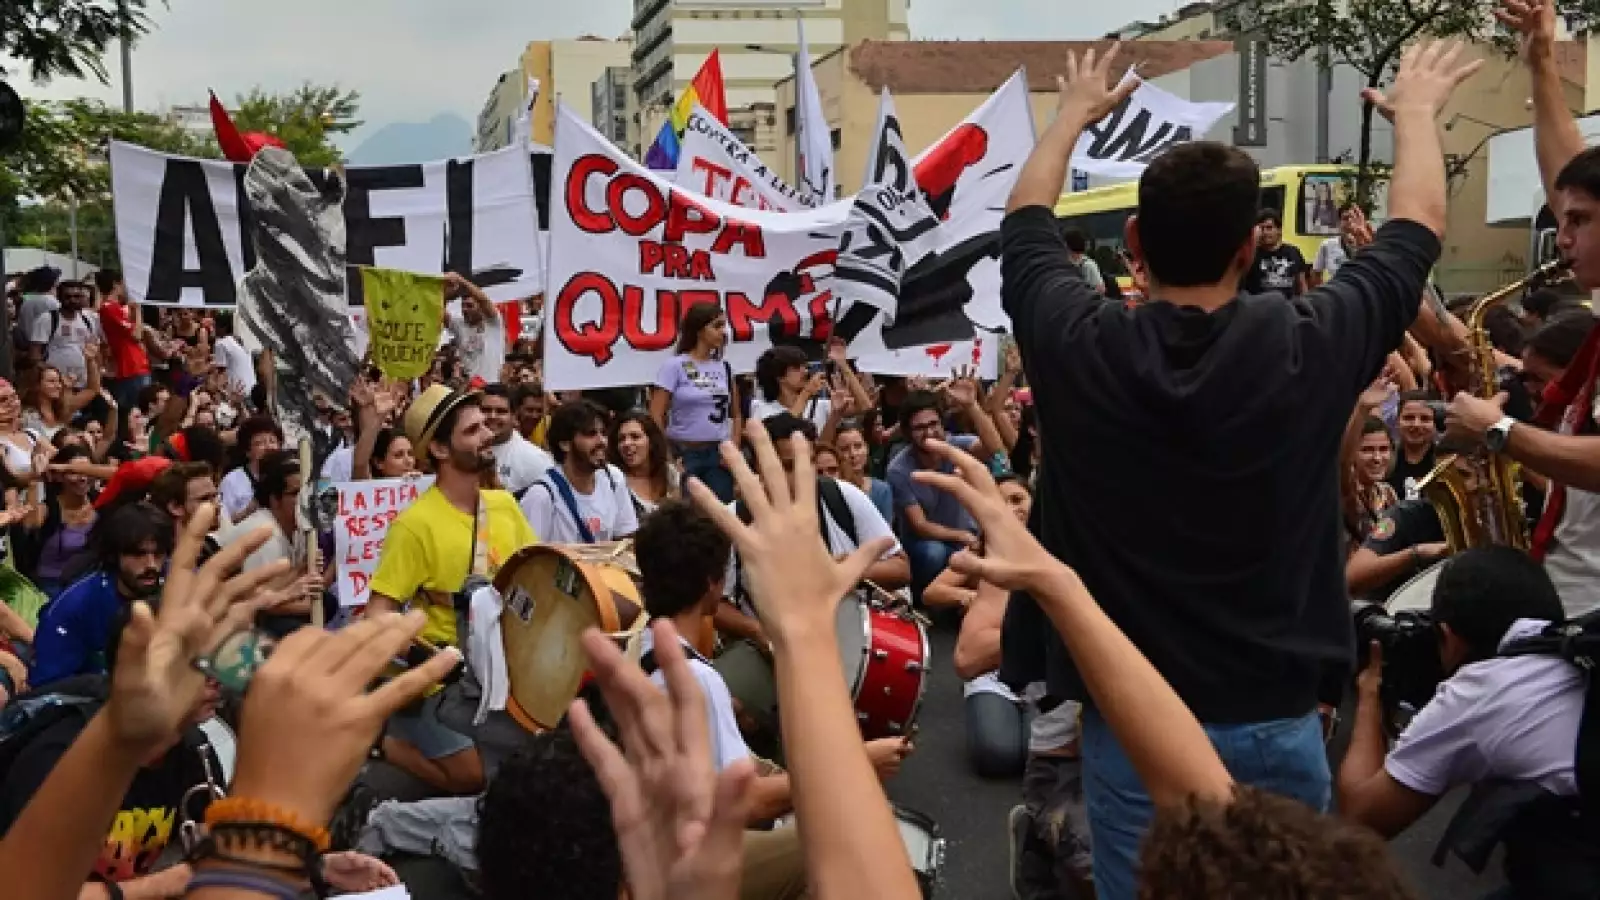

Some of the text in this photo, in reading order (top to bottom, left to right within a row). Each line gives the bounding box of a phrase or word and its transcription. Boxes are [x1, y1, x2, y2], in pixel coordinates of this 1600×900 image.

[564, 153, 766, 258] COPA
[638, 240, 716, 281] PRA
[337, 484, 419, 516] LA FIFA
